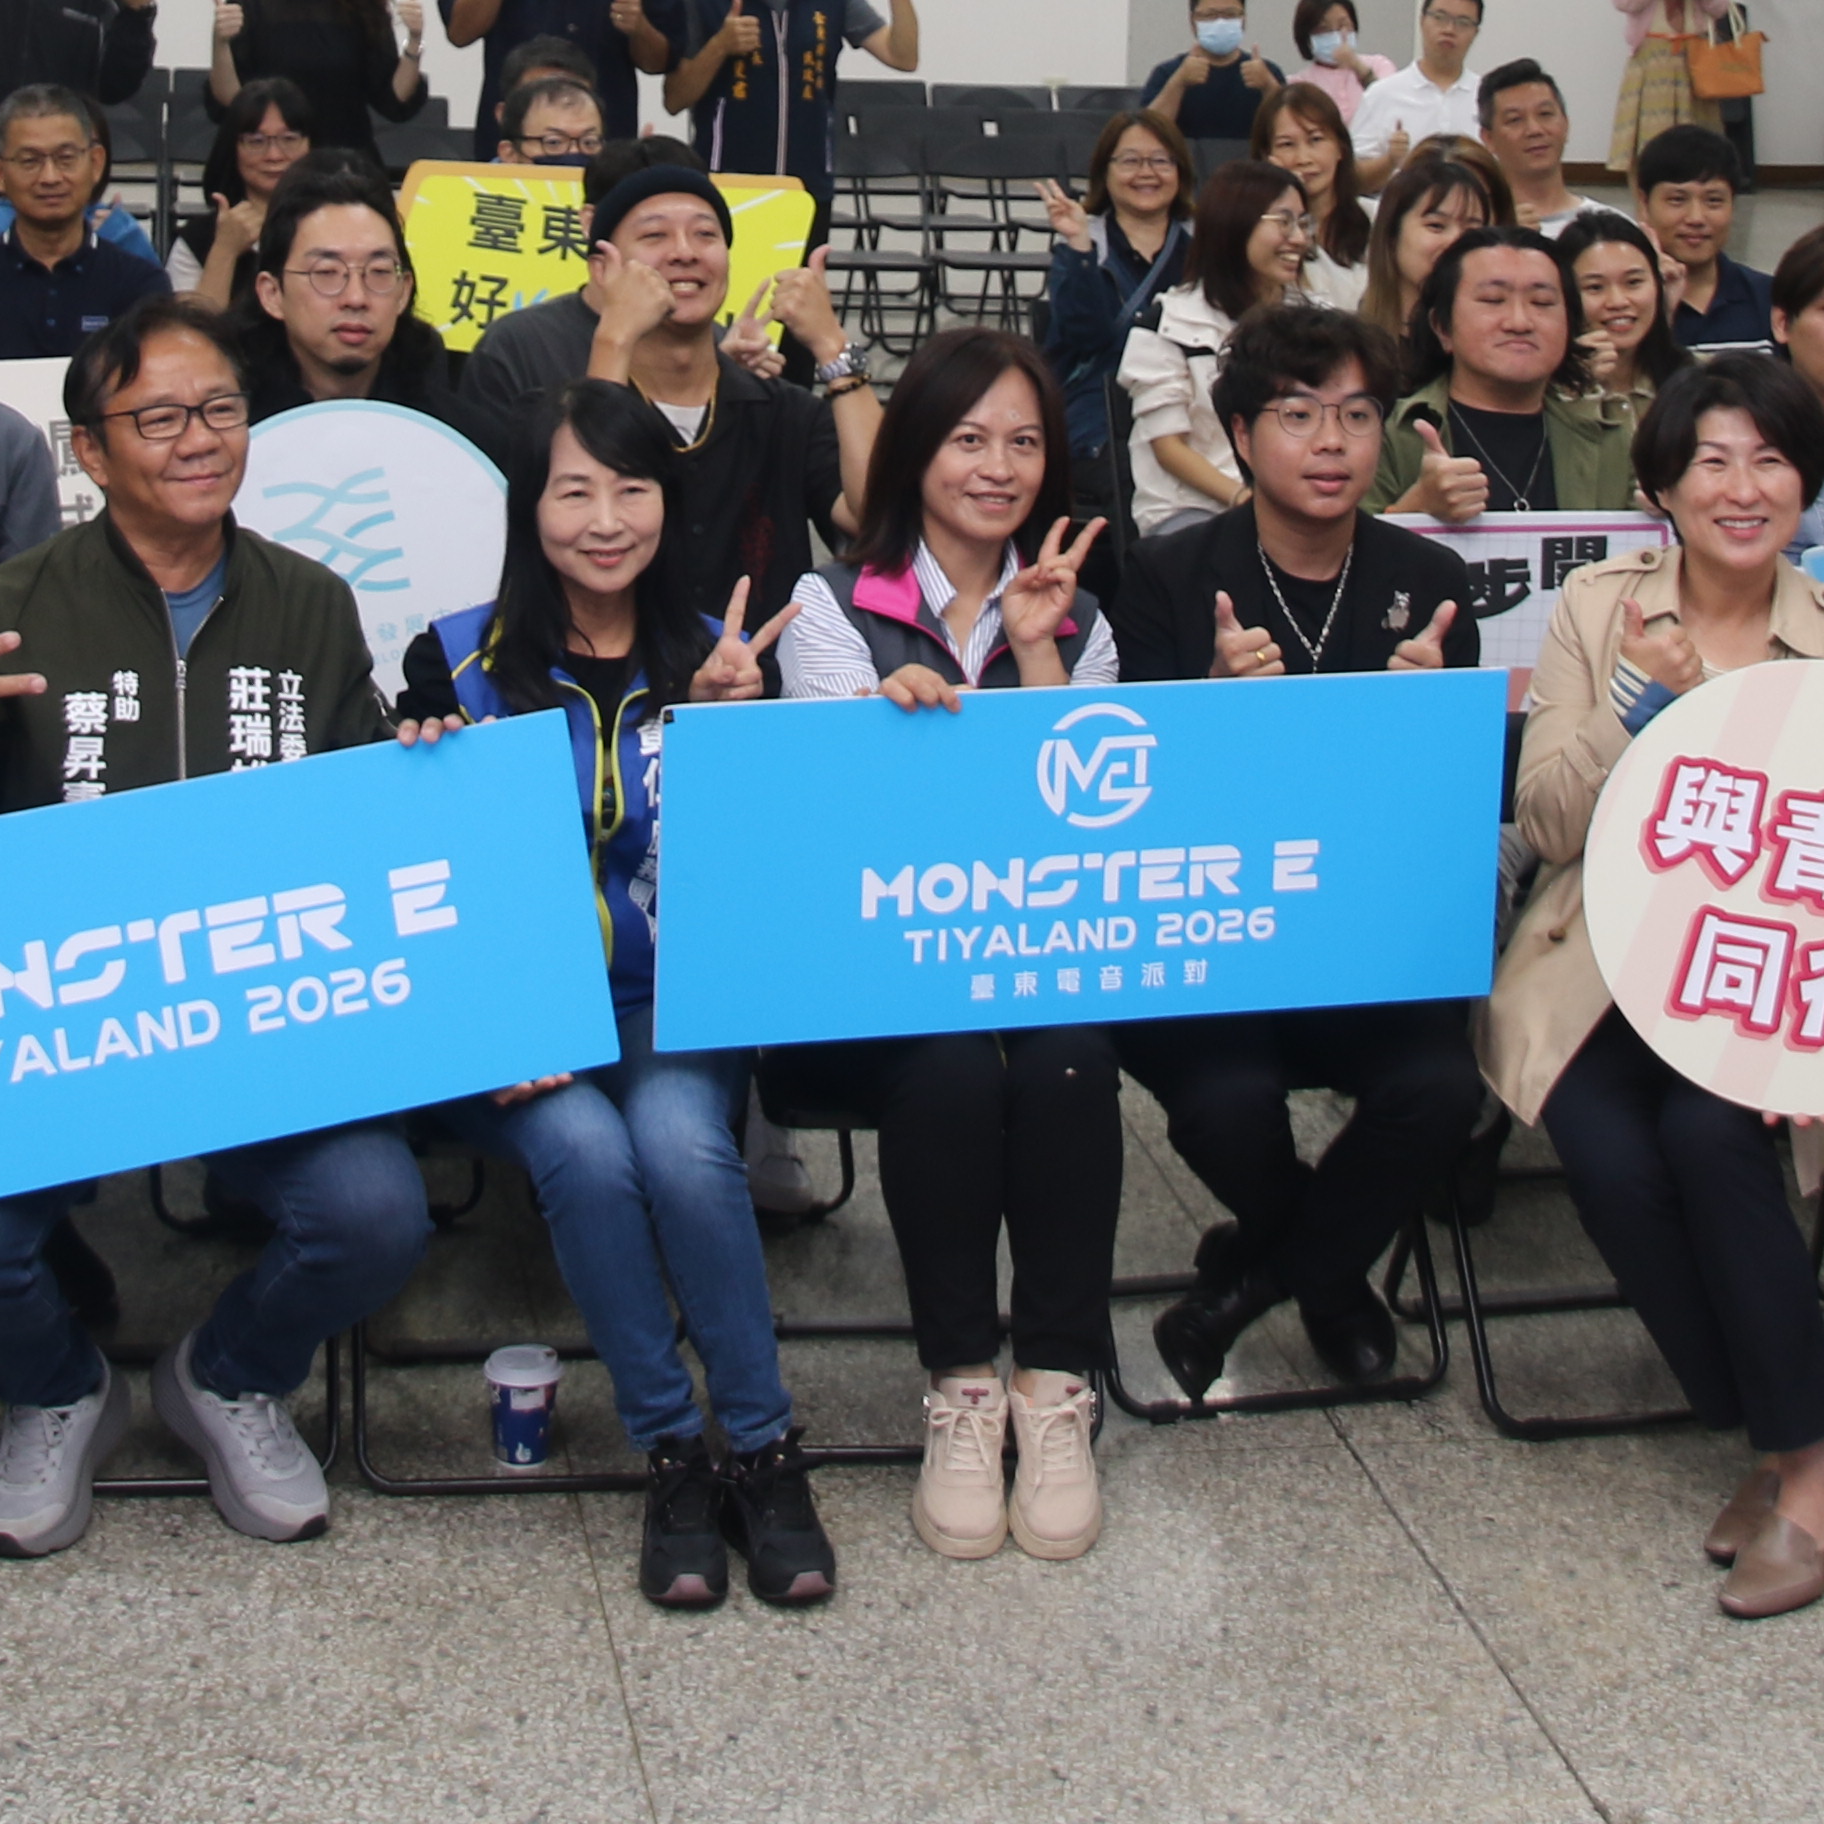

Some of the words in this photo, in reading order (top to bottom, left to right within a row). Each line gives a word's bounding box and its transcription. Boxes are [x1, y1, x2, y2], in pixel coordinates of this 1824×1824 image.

[112, 669, 141, 723] 特助
[387, 858, 459, 939] E
[860, 843, 1241, 920] MONSTER
[1272, 838, 1320, 891] E
[903, 916, 1137, 964] TIYALAND
[1155, 906, 1276, 947] 2026
[244, 957, 414, 1036] 2026
[970, 958, 1210, 1001] 臺東電音派對
